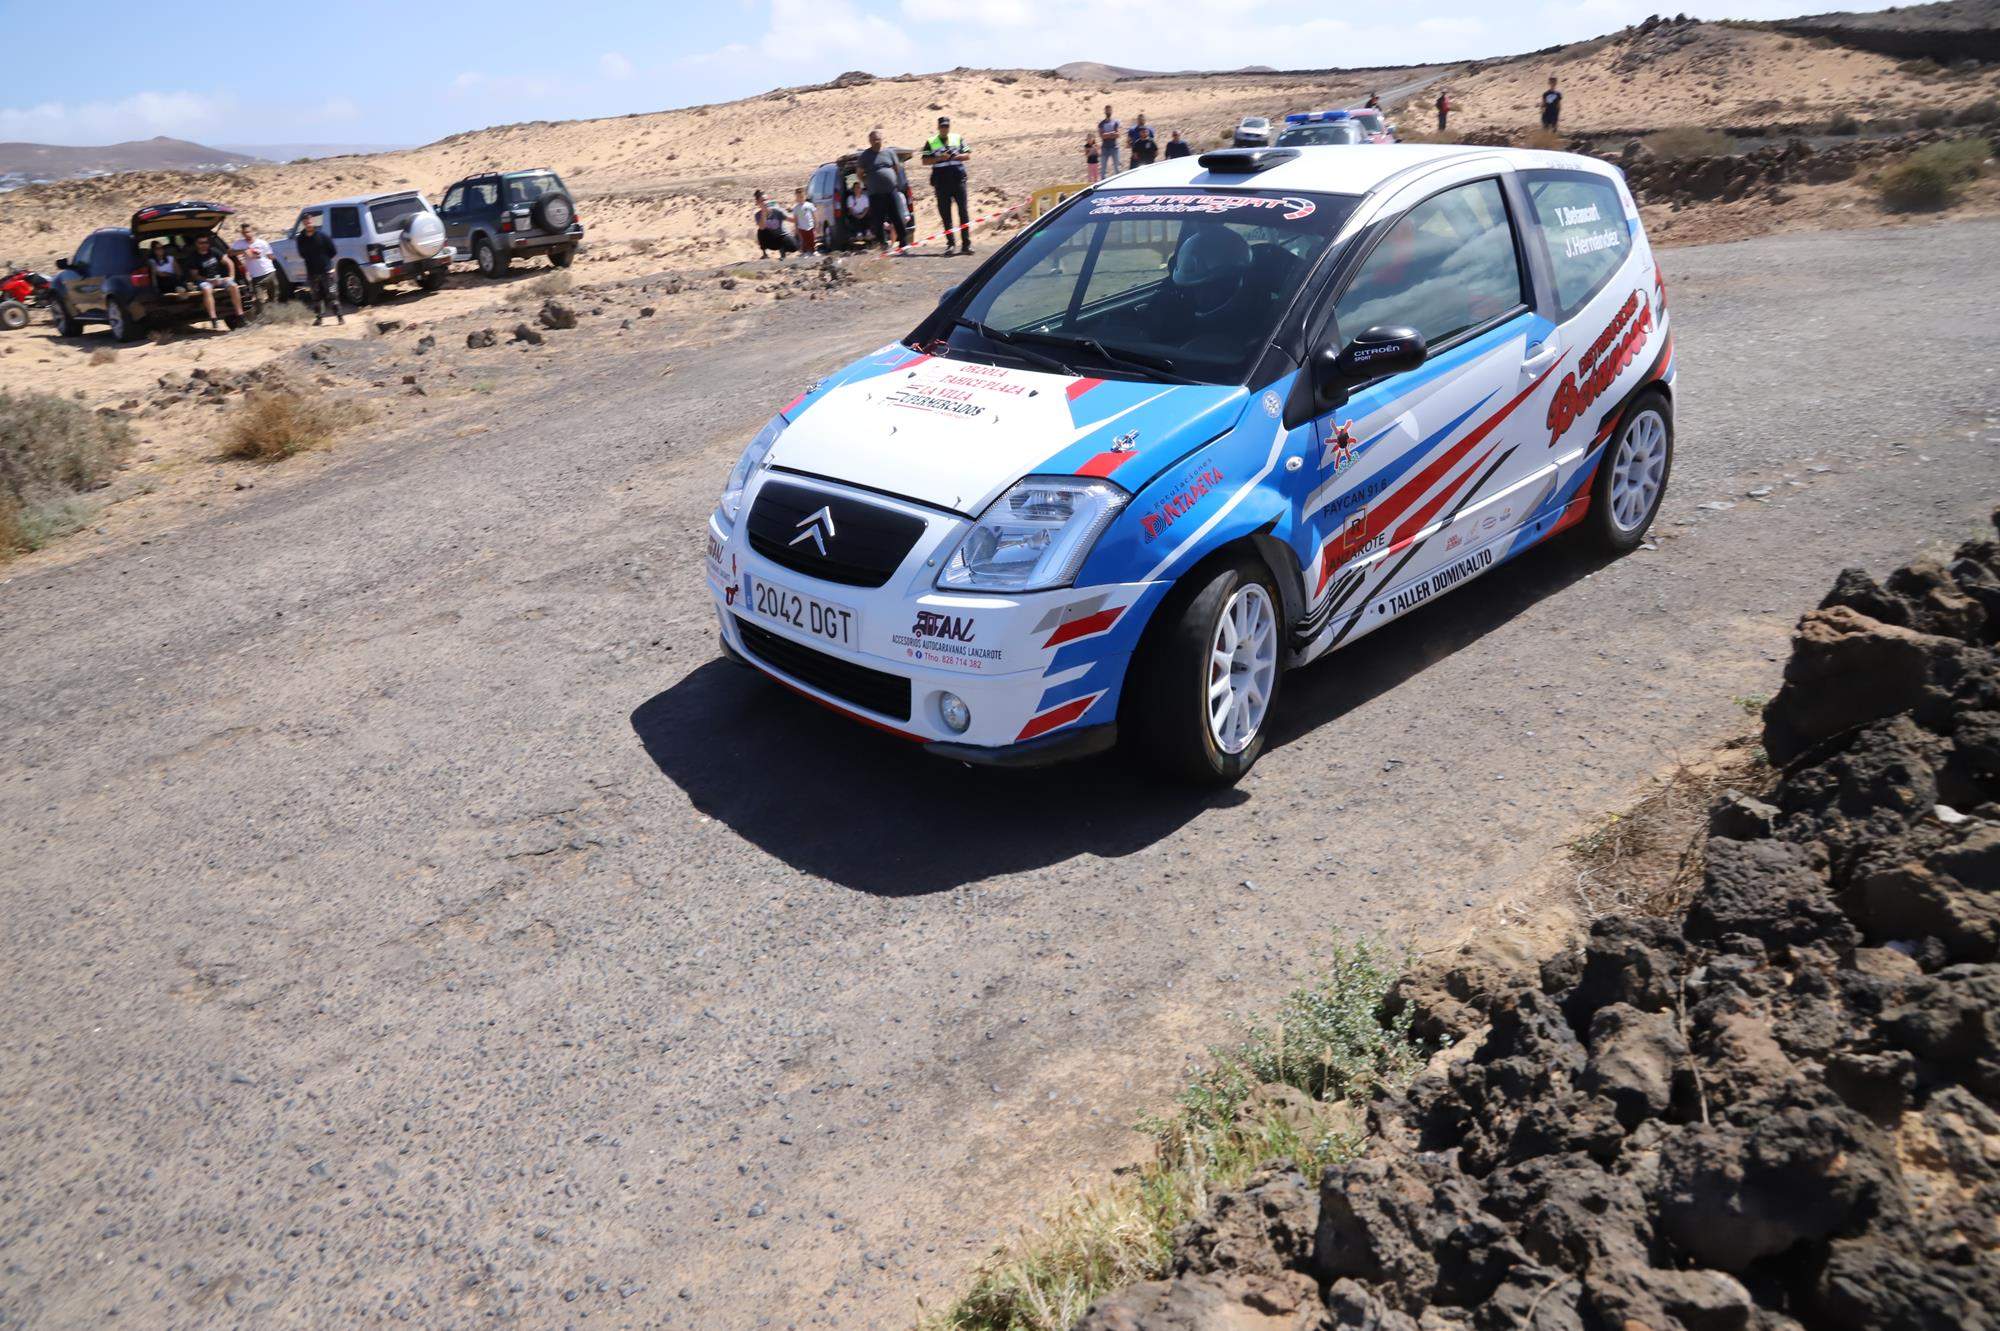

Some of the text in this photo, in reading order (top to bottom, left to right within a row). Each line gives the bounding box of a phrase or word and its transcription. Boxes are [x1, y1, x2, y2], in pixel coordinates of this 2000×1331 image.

[939, 387, 974, 401] VILLA
[982, 380, 1026, 395] PLAZA
[1389, 548, 1492, 614] TALLER DOMINAUTO
[756, 582, 851, 643] 2042 DGT
[922, 640, 967, 655] AUTOCARAVANAS
[968, 647, 1002, 660] LANZAROTE
